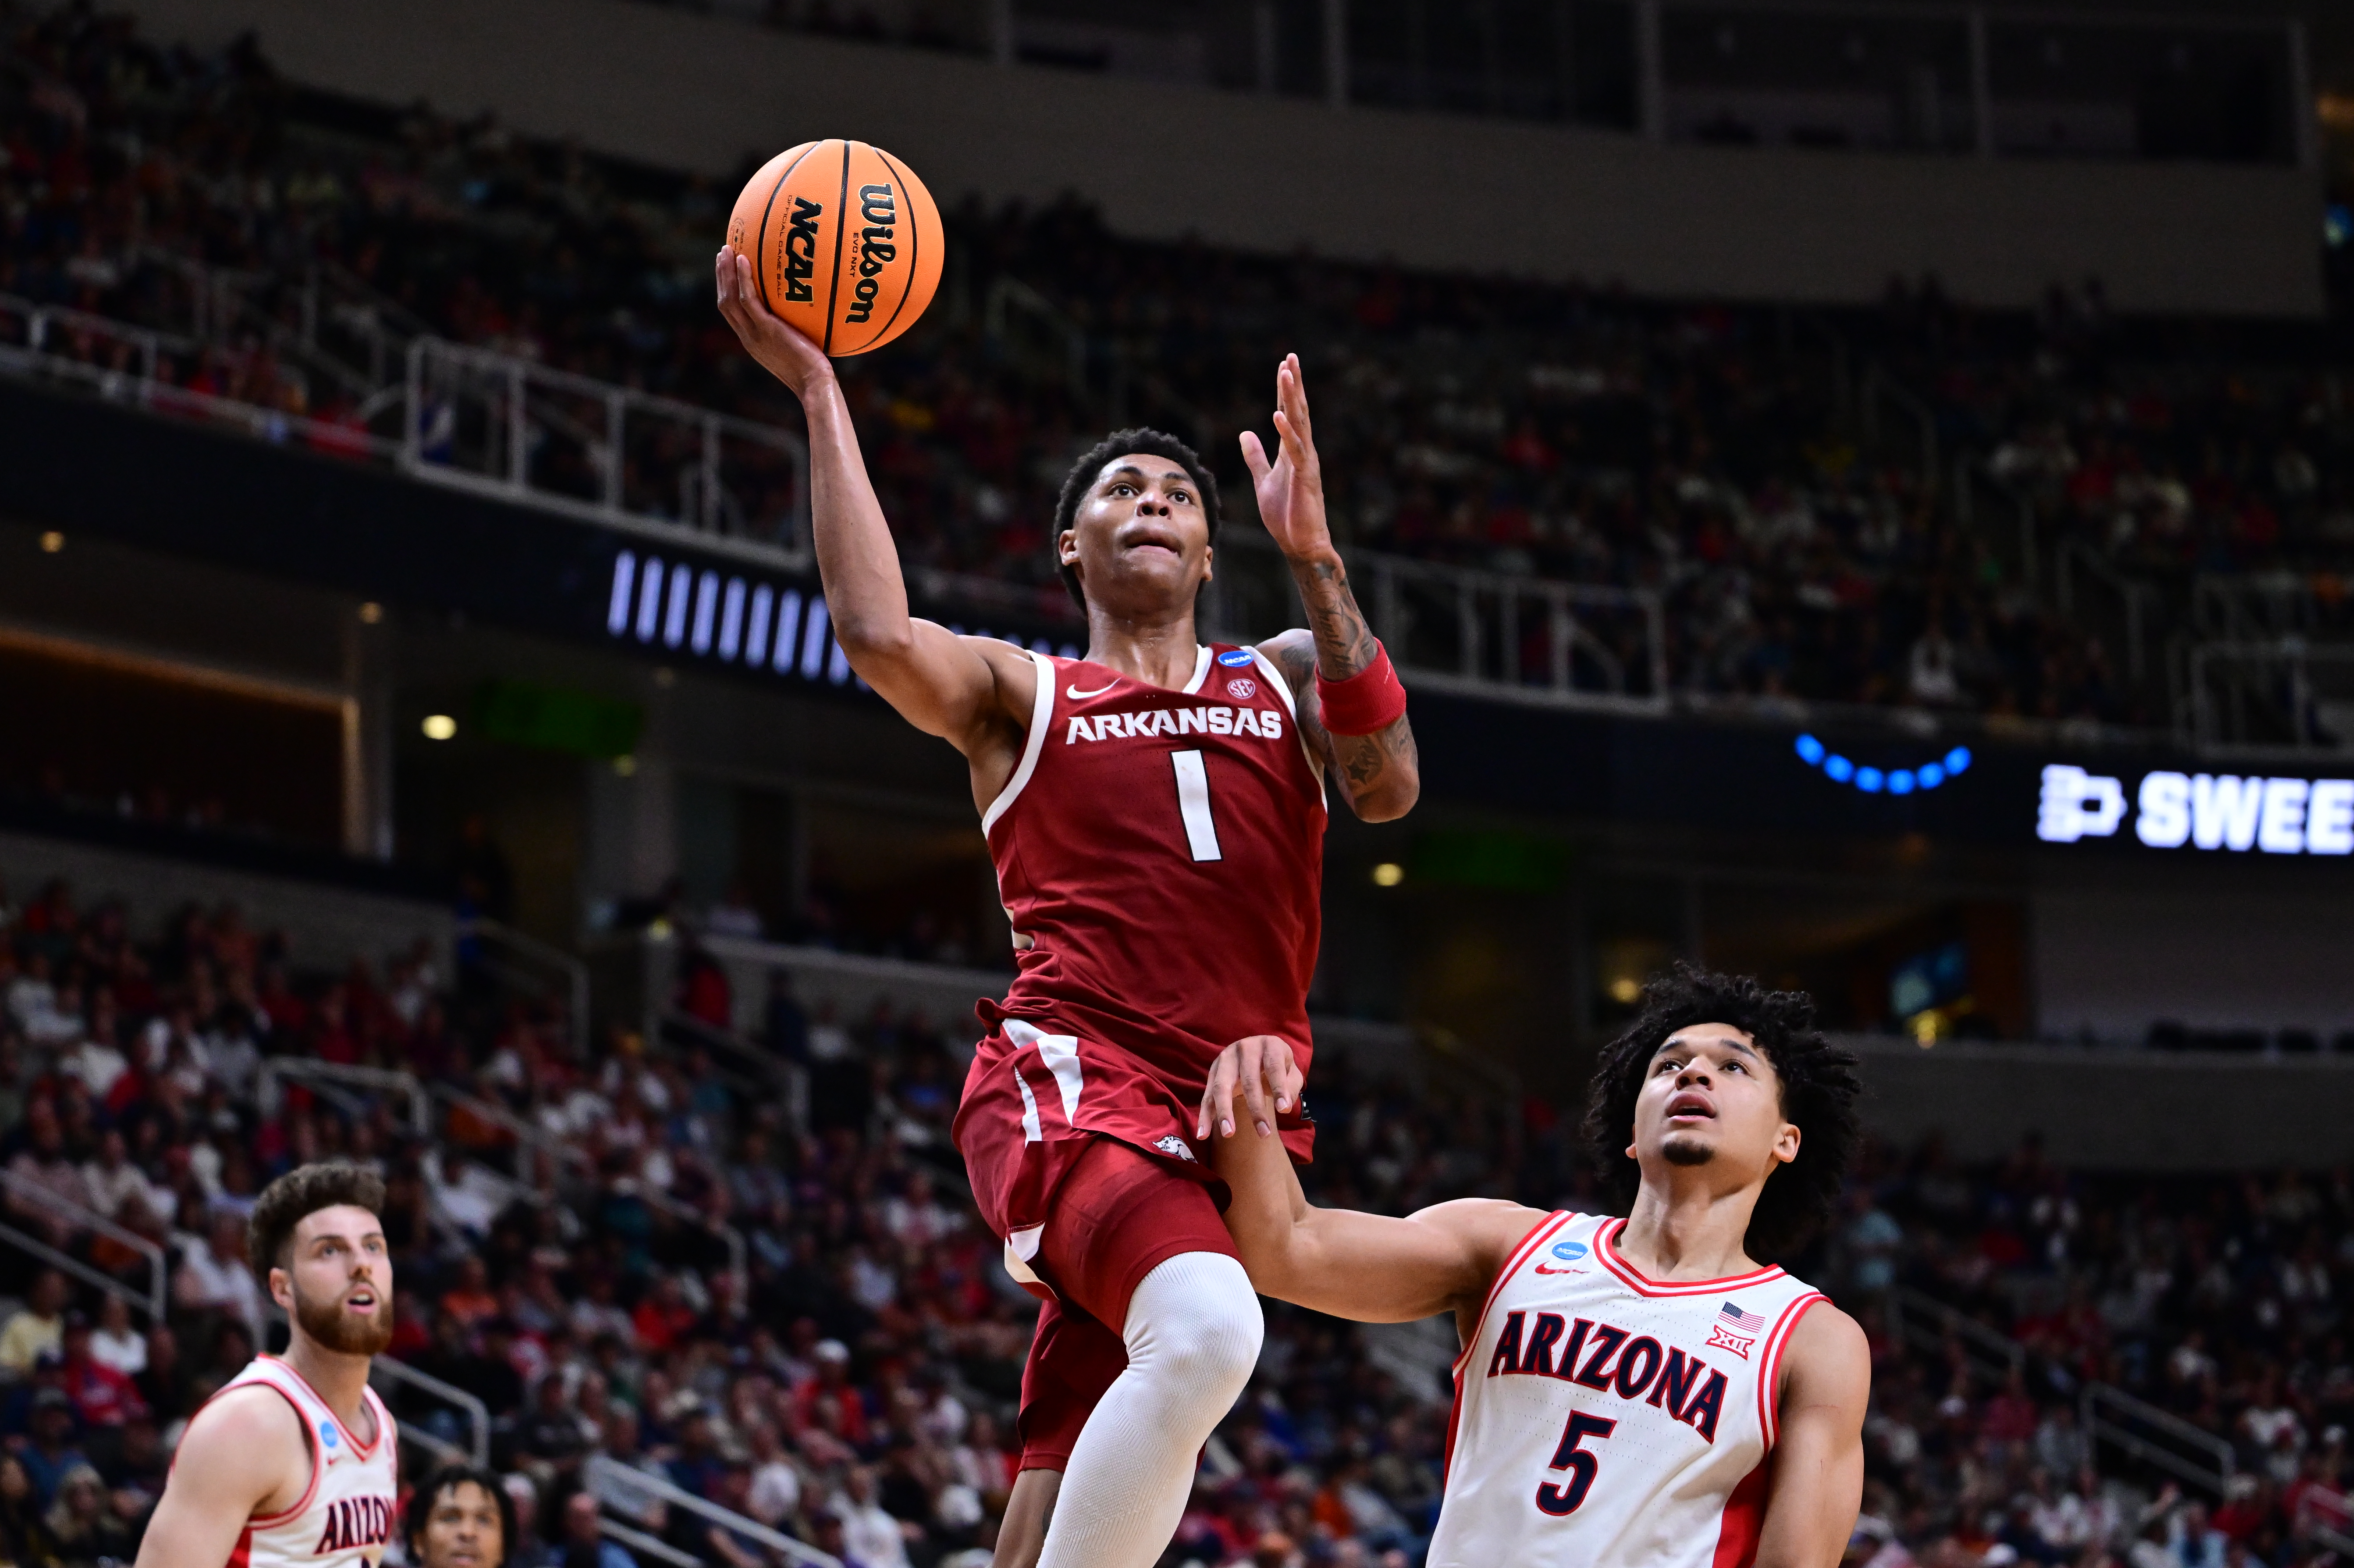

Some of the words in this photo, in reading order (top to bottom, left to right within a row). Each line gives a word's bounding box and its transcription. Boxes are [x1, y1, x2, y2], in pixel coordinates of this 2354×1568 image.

[779, 195, 792, 238] OFFICIAL
[784, 196, 823, 303] NCAA
[845, 183, 896, 324] Wilson
[849, 257, 857, 277] NXT
[1224, 655, 1251, 664] NCAA
[1230, 680, 1253, 697] SEC
[1066, 707, 1282, 745] ARKANSAS
[1170, 749, 1223, 862] 1
[1487, 1311, 1729, 1444] ARIZONA
[1536, 1410, 1617, 1516] 5
